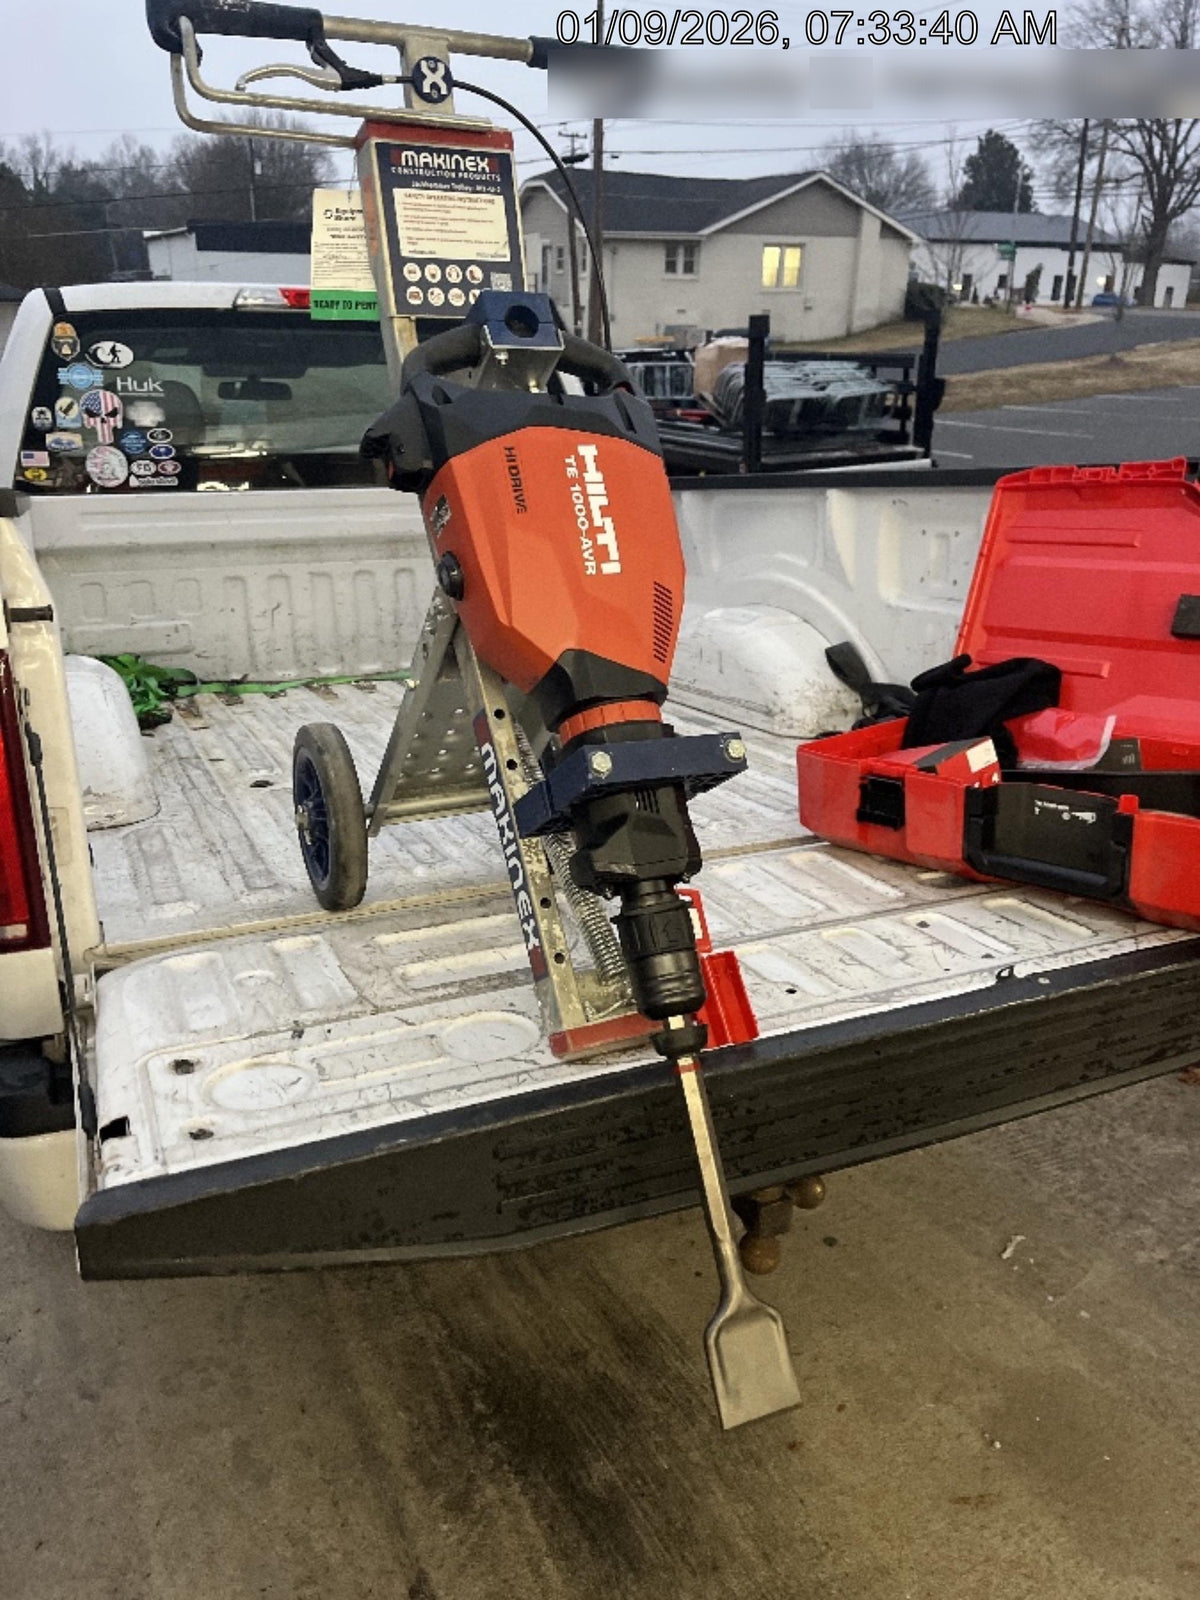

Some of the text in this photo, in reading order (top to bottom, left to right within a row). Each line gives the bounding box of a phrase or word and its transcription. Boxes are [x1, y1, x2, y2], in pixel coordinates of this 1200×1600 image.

[401, 150, 490, 173] MAKINEX
[117, 376, 164, 392] Huk
[564, 455, 597, 575] TE 1000-AVR
[577, 444, 621, 575] HILTI
[480, 742, 540, 950] MAKINEX
